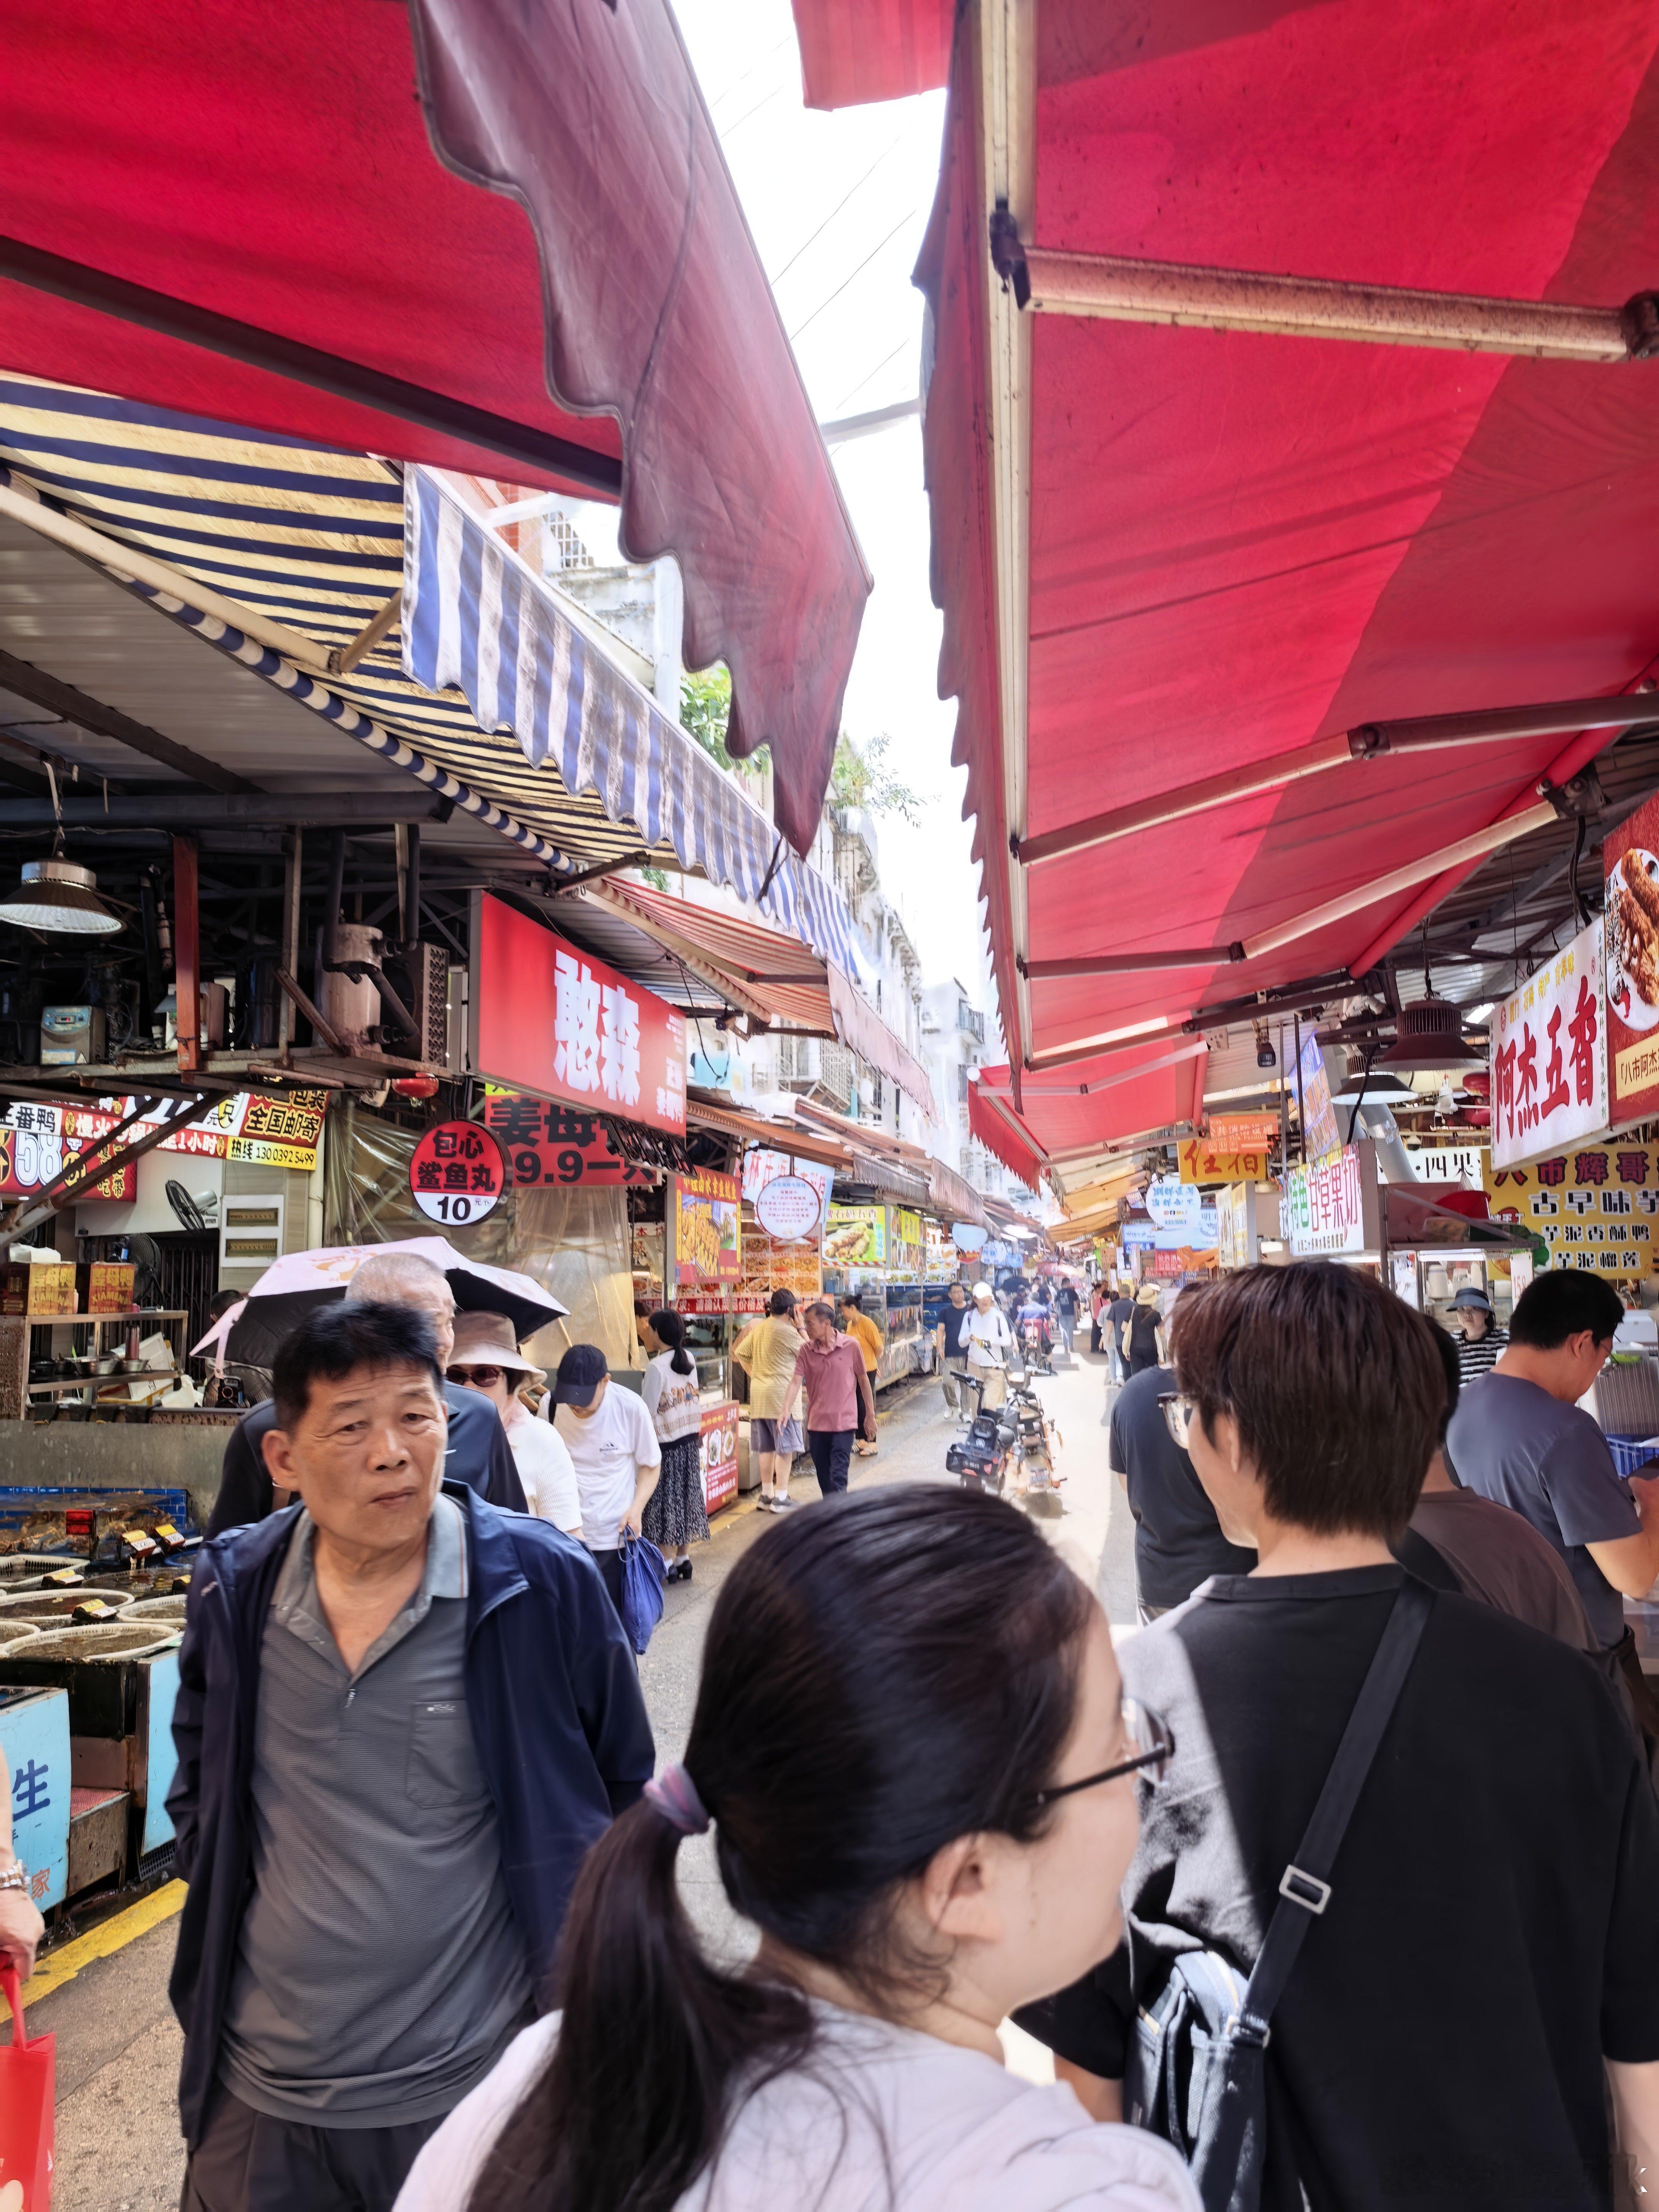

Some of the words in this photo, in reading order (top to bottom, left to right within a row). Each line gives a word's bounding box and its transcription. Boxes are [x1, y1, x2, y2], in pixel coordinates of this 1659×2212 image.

[1495, 975, 1597, 1145] 阿杰五香
[1621, 1048, 1659, 1086] 「八市阿杰
[254, 1091, 326, 1112] 包装
[245, 1104, 320, 1142] 全国邮寄
[490, 1098, 611, 1154] 姜母
[231, 1139, 253, 1159] 热线
[273, 1147, 293, 1163] 0392
[432, 1130, 484, 1159] 包心
[417, 1161, 496, 1192] 鲨鱼丸
[437, 1196, 471, 1221] 10
[12, 1759, 51, 1823] 生
